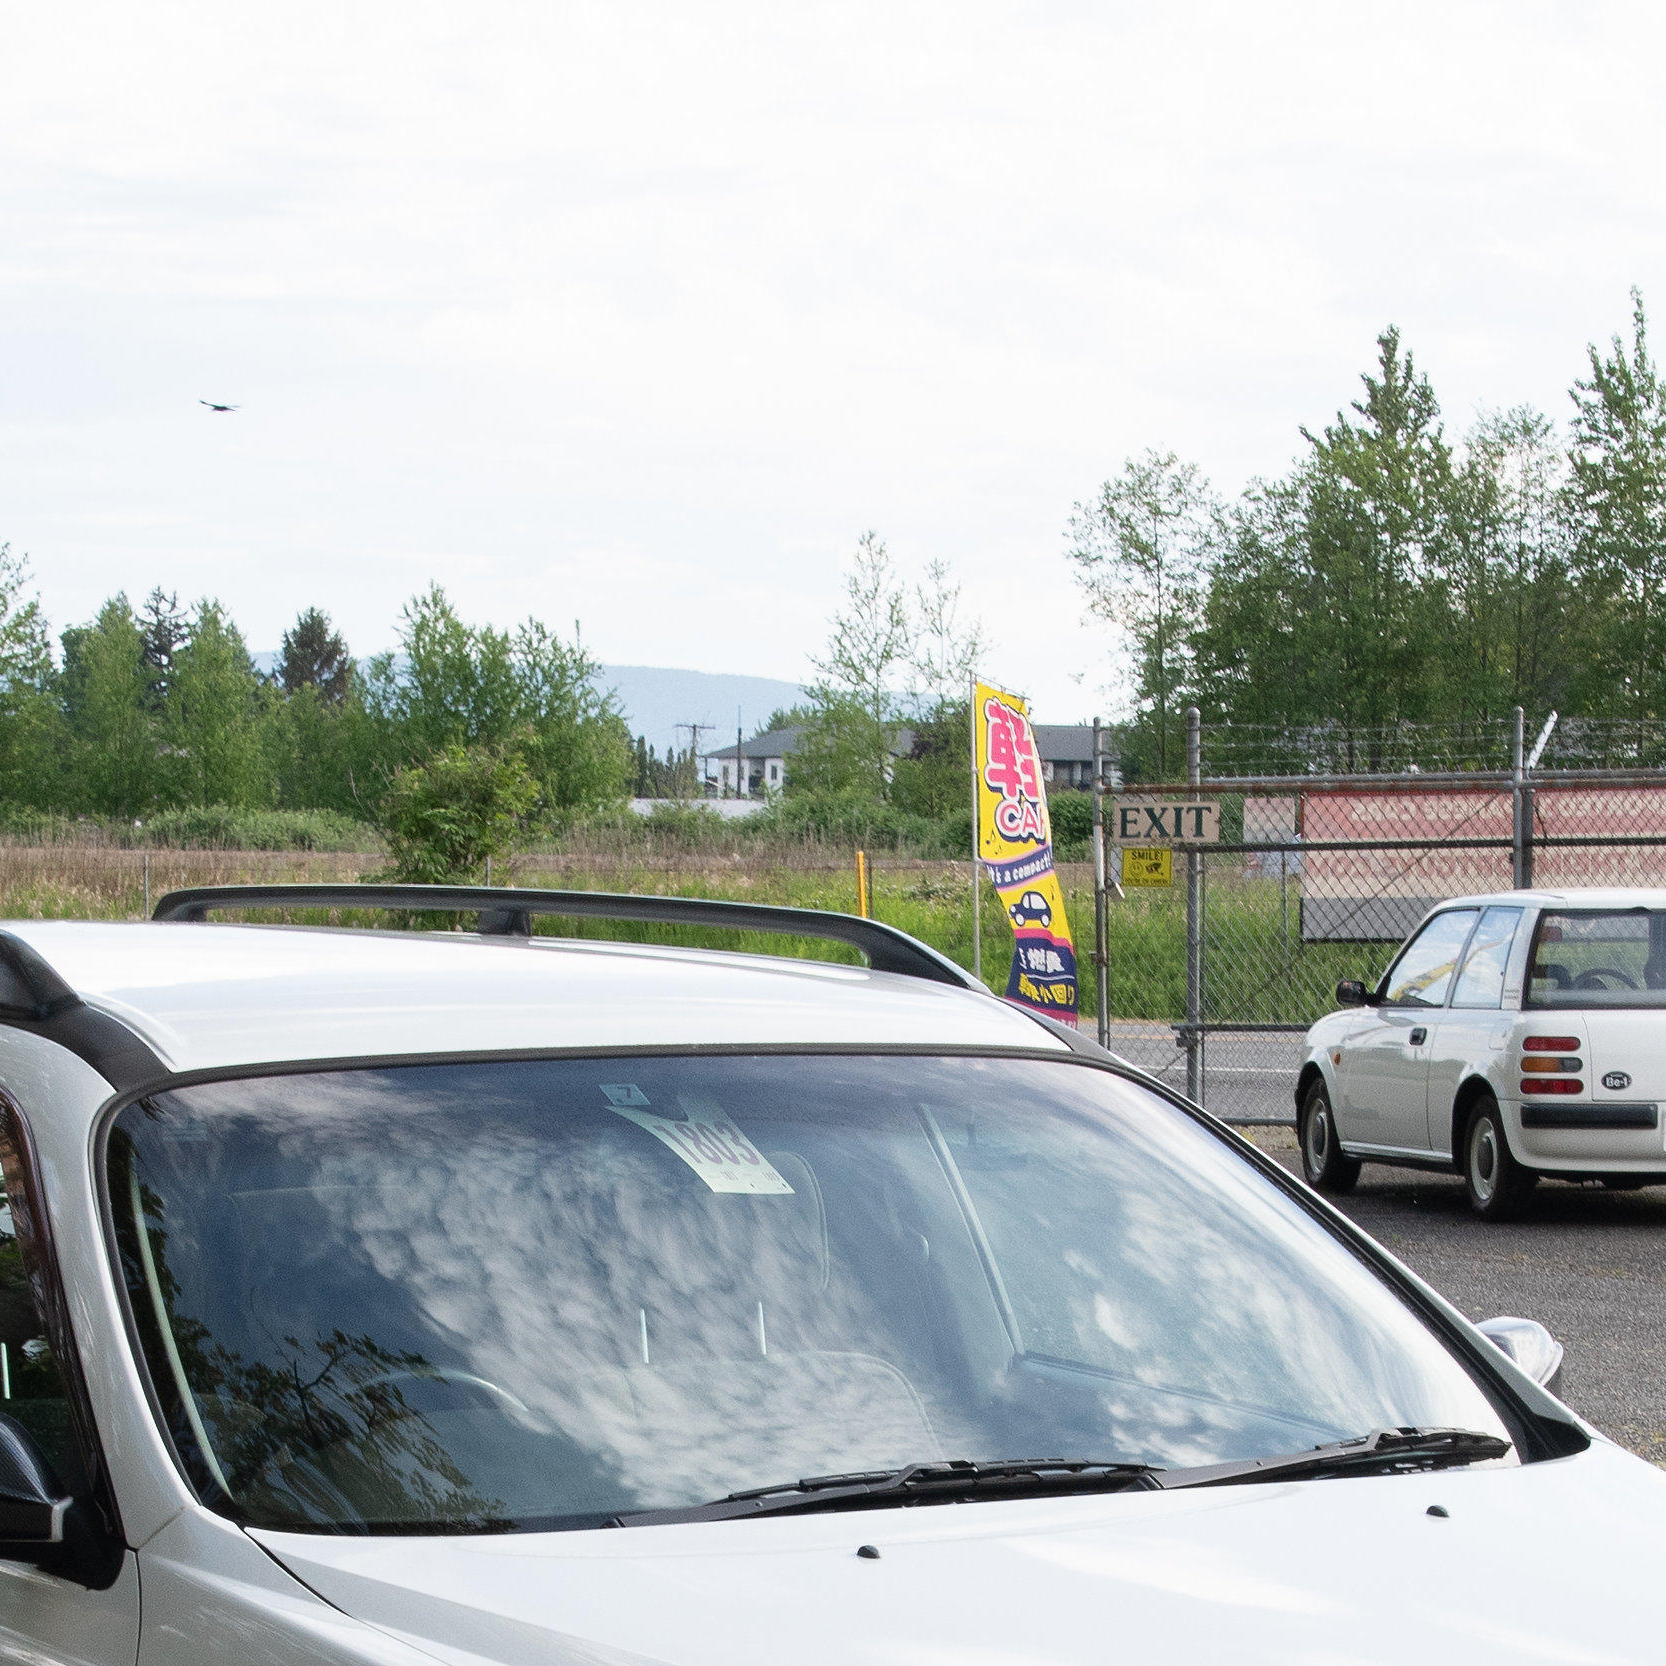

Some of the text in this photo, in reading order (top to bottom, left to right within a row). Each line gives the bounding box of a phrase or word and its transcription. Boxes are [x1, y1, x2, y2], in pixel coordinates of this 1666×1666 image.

[995, 801, 1046, 842] CA
[1119, 806, 1212, 838] EXIT
[1131, 849, 1163, 861] SMILE!
[1004, 870, 1012, 883] a
[1605, 1075, 1628, 1087] Be-1
[653, 1120, 760, 1166] 1803
